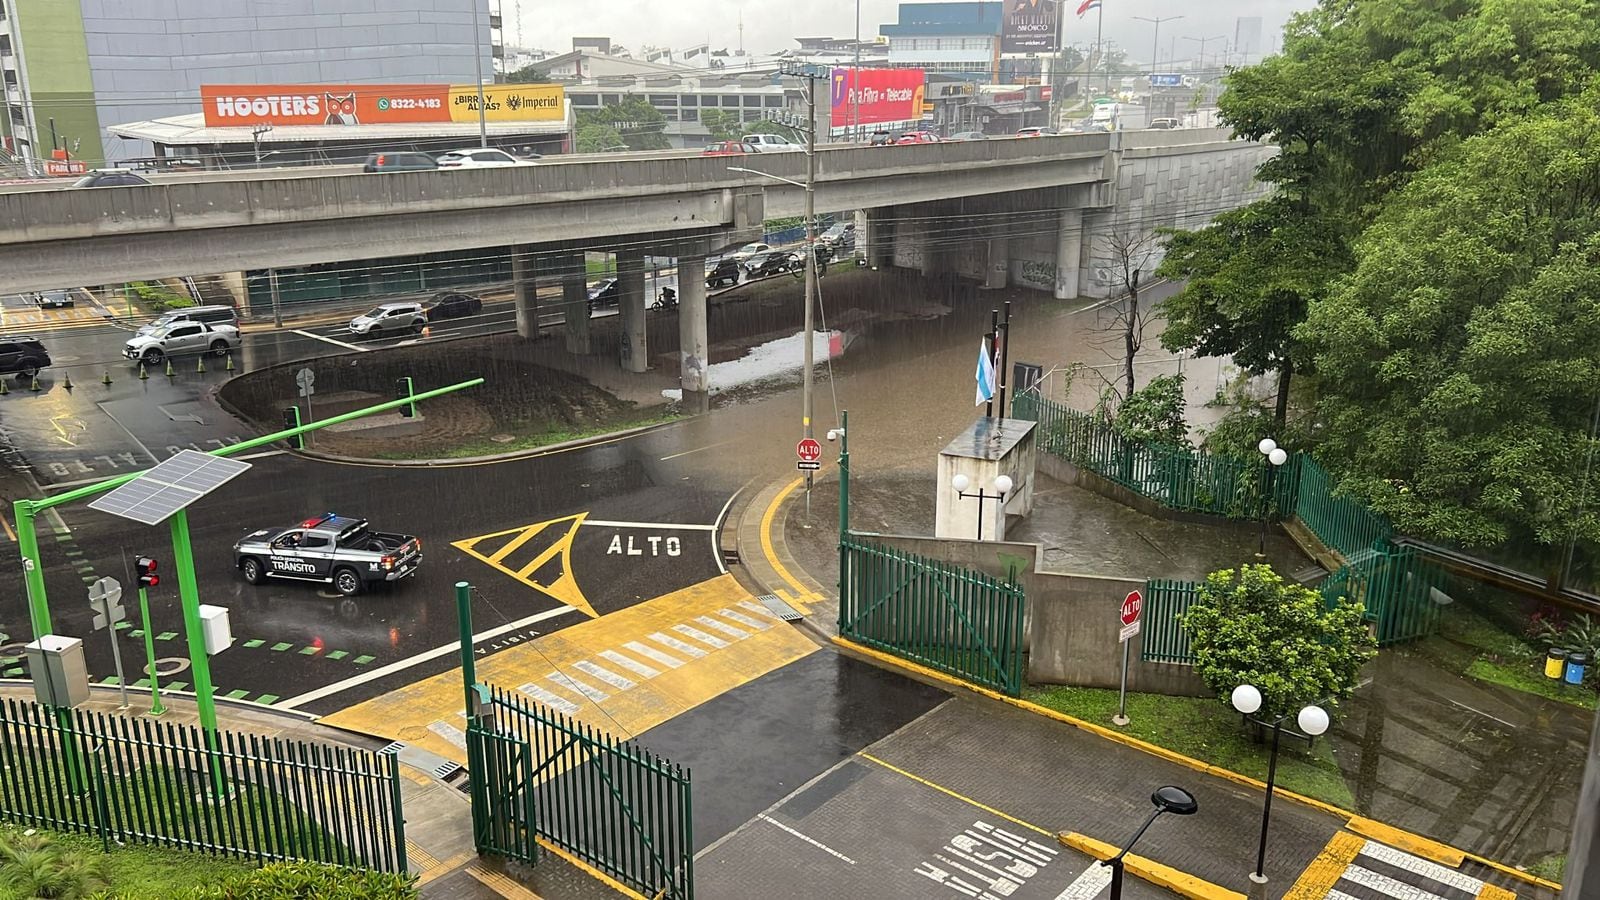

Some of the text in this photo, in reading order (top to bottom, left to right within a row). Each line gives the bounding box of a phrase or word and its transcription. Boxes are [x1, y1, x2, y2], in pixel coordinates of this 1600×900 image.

[487, 95, 492, 103] Y
[886, 87, 912, 102] Telecable
[216, 96, 320, 117] HOOTERS
[391, 98, 441, 109] 8322-4183
[522, 95, 558, 110] Imperial
[800, 445, 819, 455] ALTO
[49, 452, 138, 476] ALTO
[606, 534, 681, 556] ALTO
[272, 560, 316, 573] TRÁNSITO
[1122, 599, 1140, 618] ALTO
